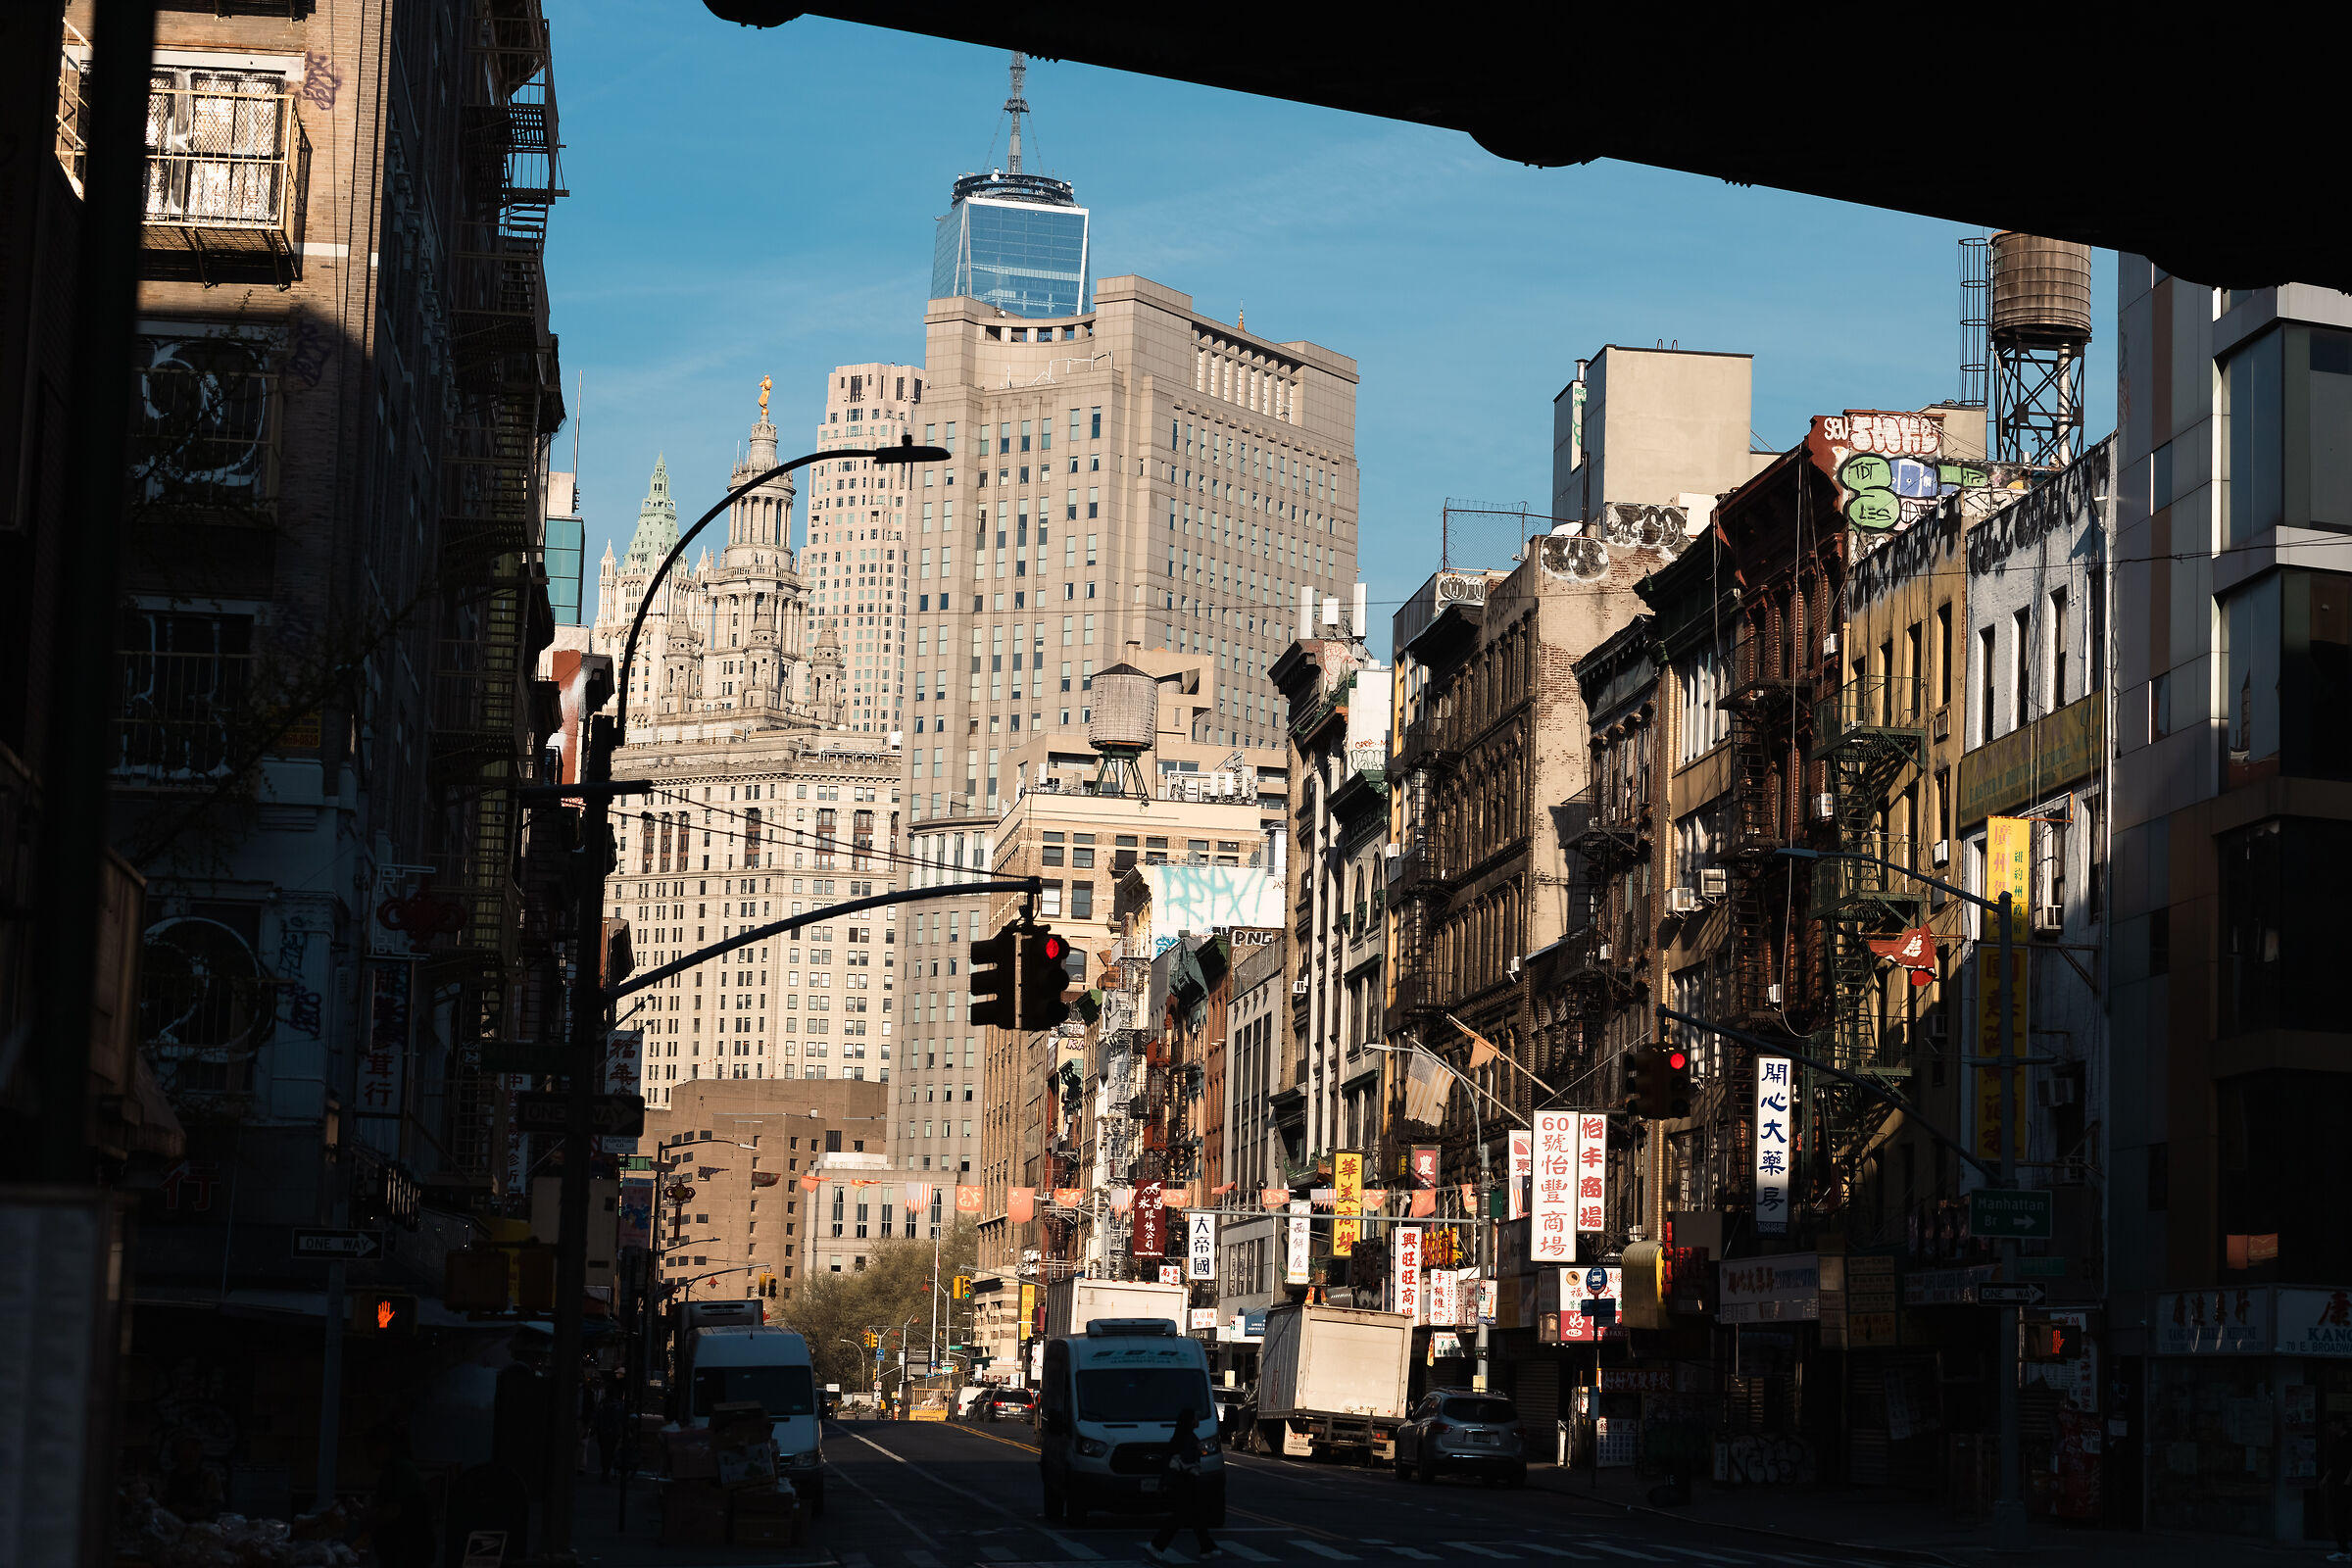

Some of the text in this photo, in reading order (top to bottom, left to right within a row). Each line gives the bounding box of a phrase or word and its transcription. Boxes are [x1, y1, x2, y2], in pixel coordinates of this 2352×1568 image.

[529, 1103, 565, 1121] ONE
[1758, 1062, 1788, 1212] 開心大藥房
[1978, 1198, 2045, 1211] Manhattan
[1984, 1215, 1998, 1227] Br
[306, 1238, 368, 1251] ONE WAY
[1194, 1216, 1210, 1275] 大帝國
[1984, 1289, 2035, 1298] ONE WAY
